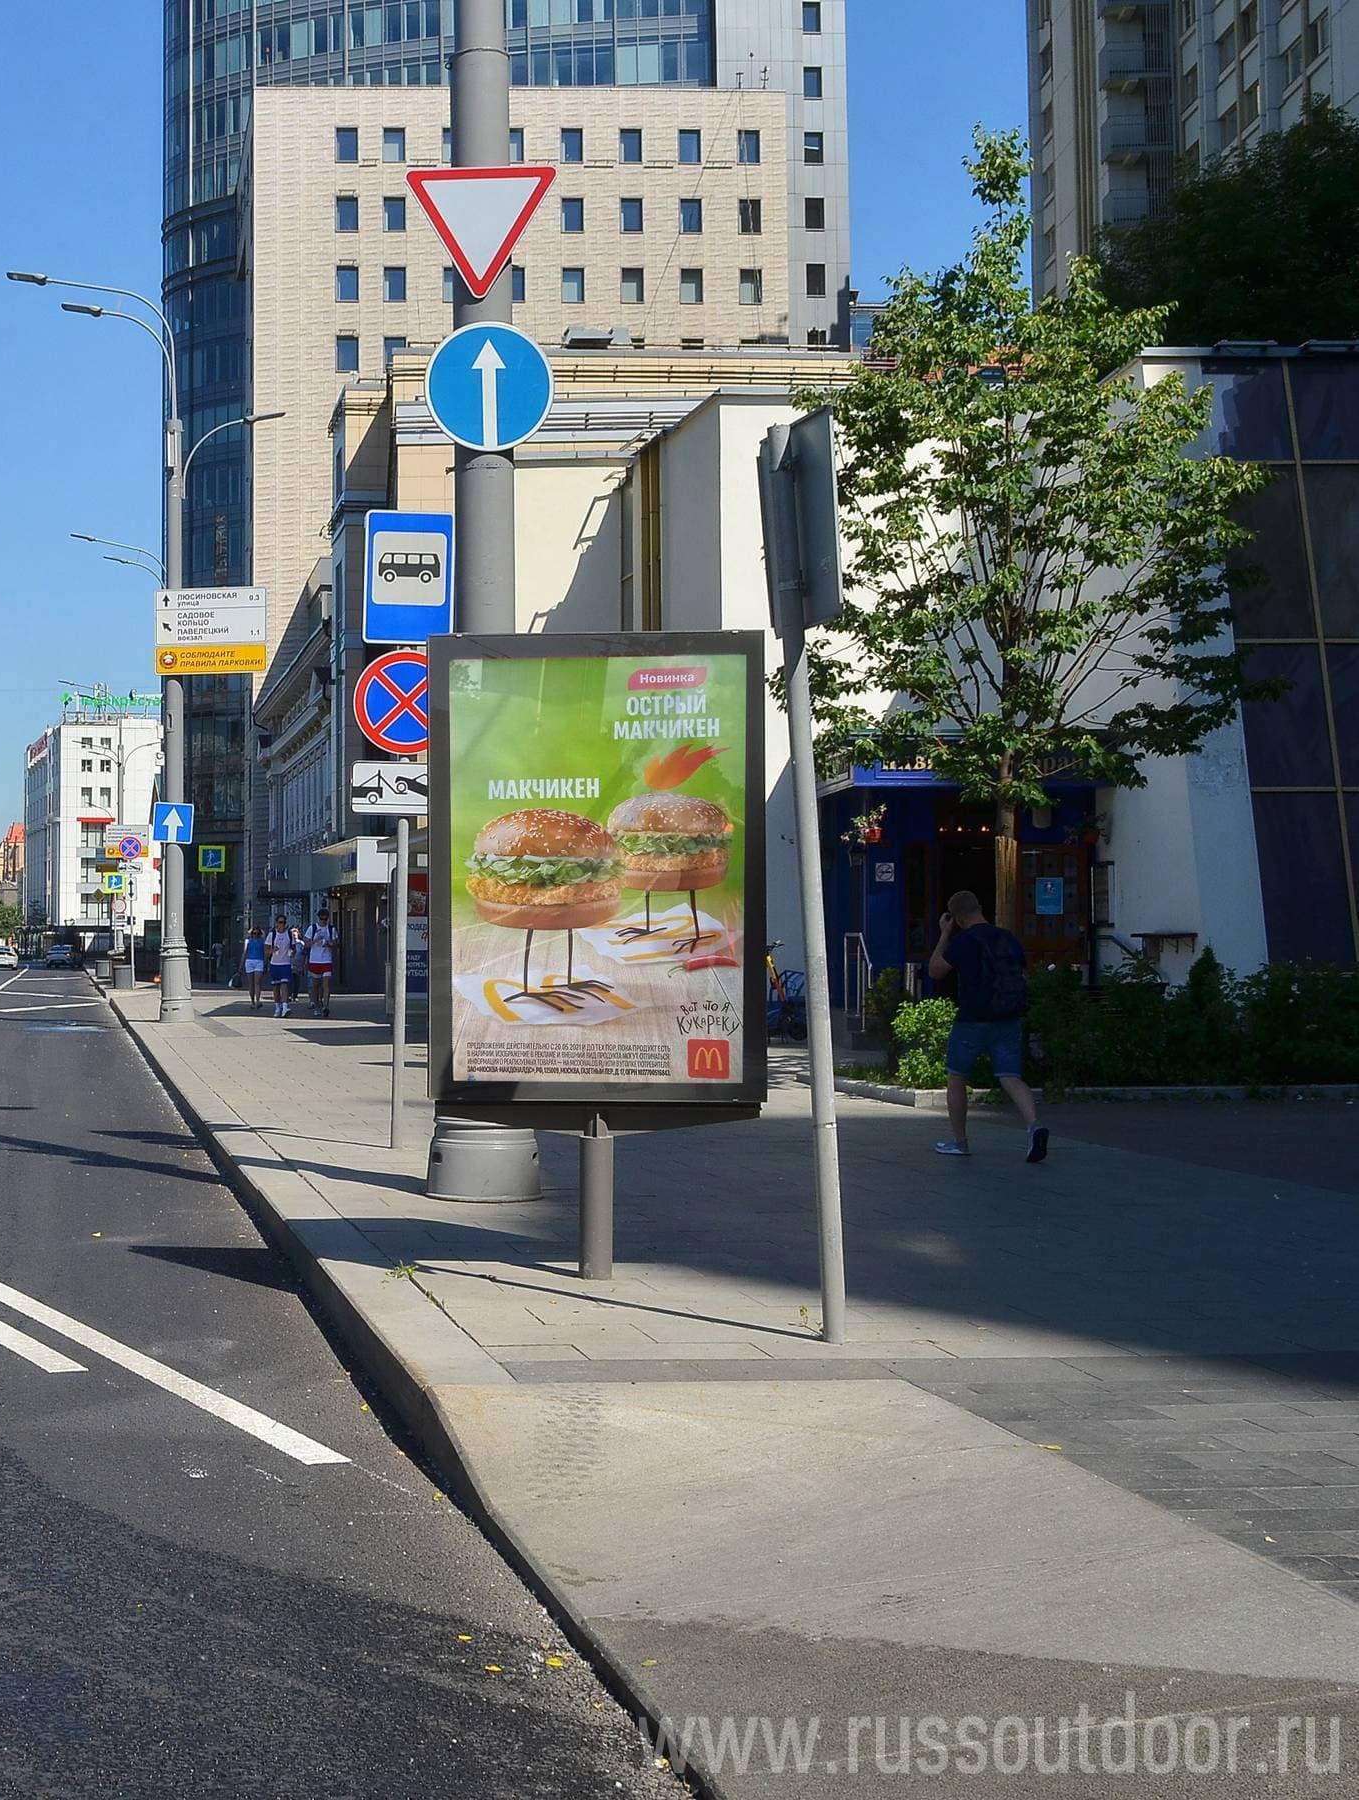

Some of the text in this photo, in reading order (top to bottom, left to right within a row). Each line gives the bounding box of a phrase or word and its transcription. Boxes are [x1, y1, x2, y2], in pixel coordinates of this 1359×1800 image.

[177, 592, 238, 601] ЛЮСИНОВСКАЯ
[177, 611, 215, 619] САДОВОЕ
[177, 619, 209, 627] КОЛЬЦО
[177, 627, 229, 636] ПАВЕЛЕЦКИЙ
[218, 658, 263, 666] ПАРКОВКИ!
[640, 673, 695, 684] Новинка
[626, 688, 706, 716] ОСТРЫЙ
[613, 718, 720, 740] МАКЧИКЕН
[488, 777, 600, 800] МАКЧИКЕН
[506, 1041, 550, 1050] ДЕЙСТВИТЕЛЬНО
